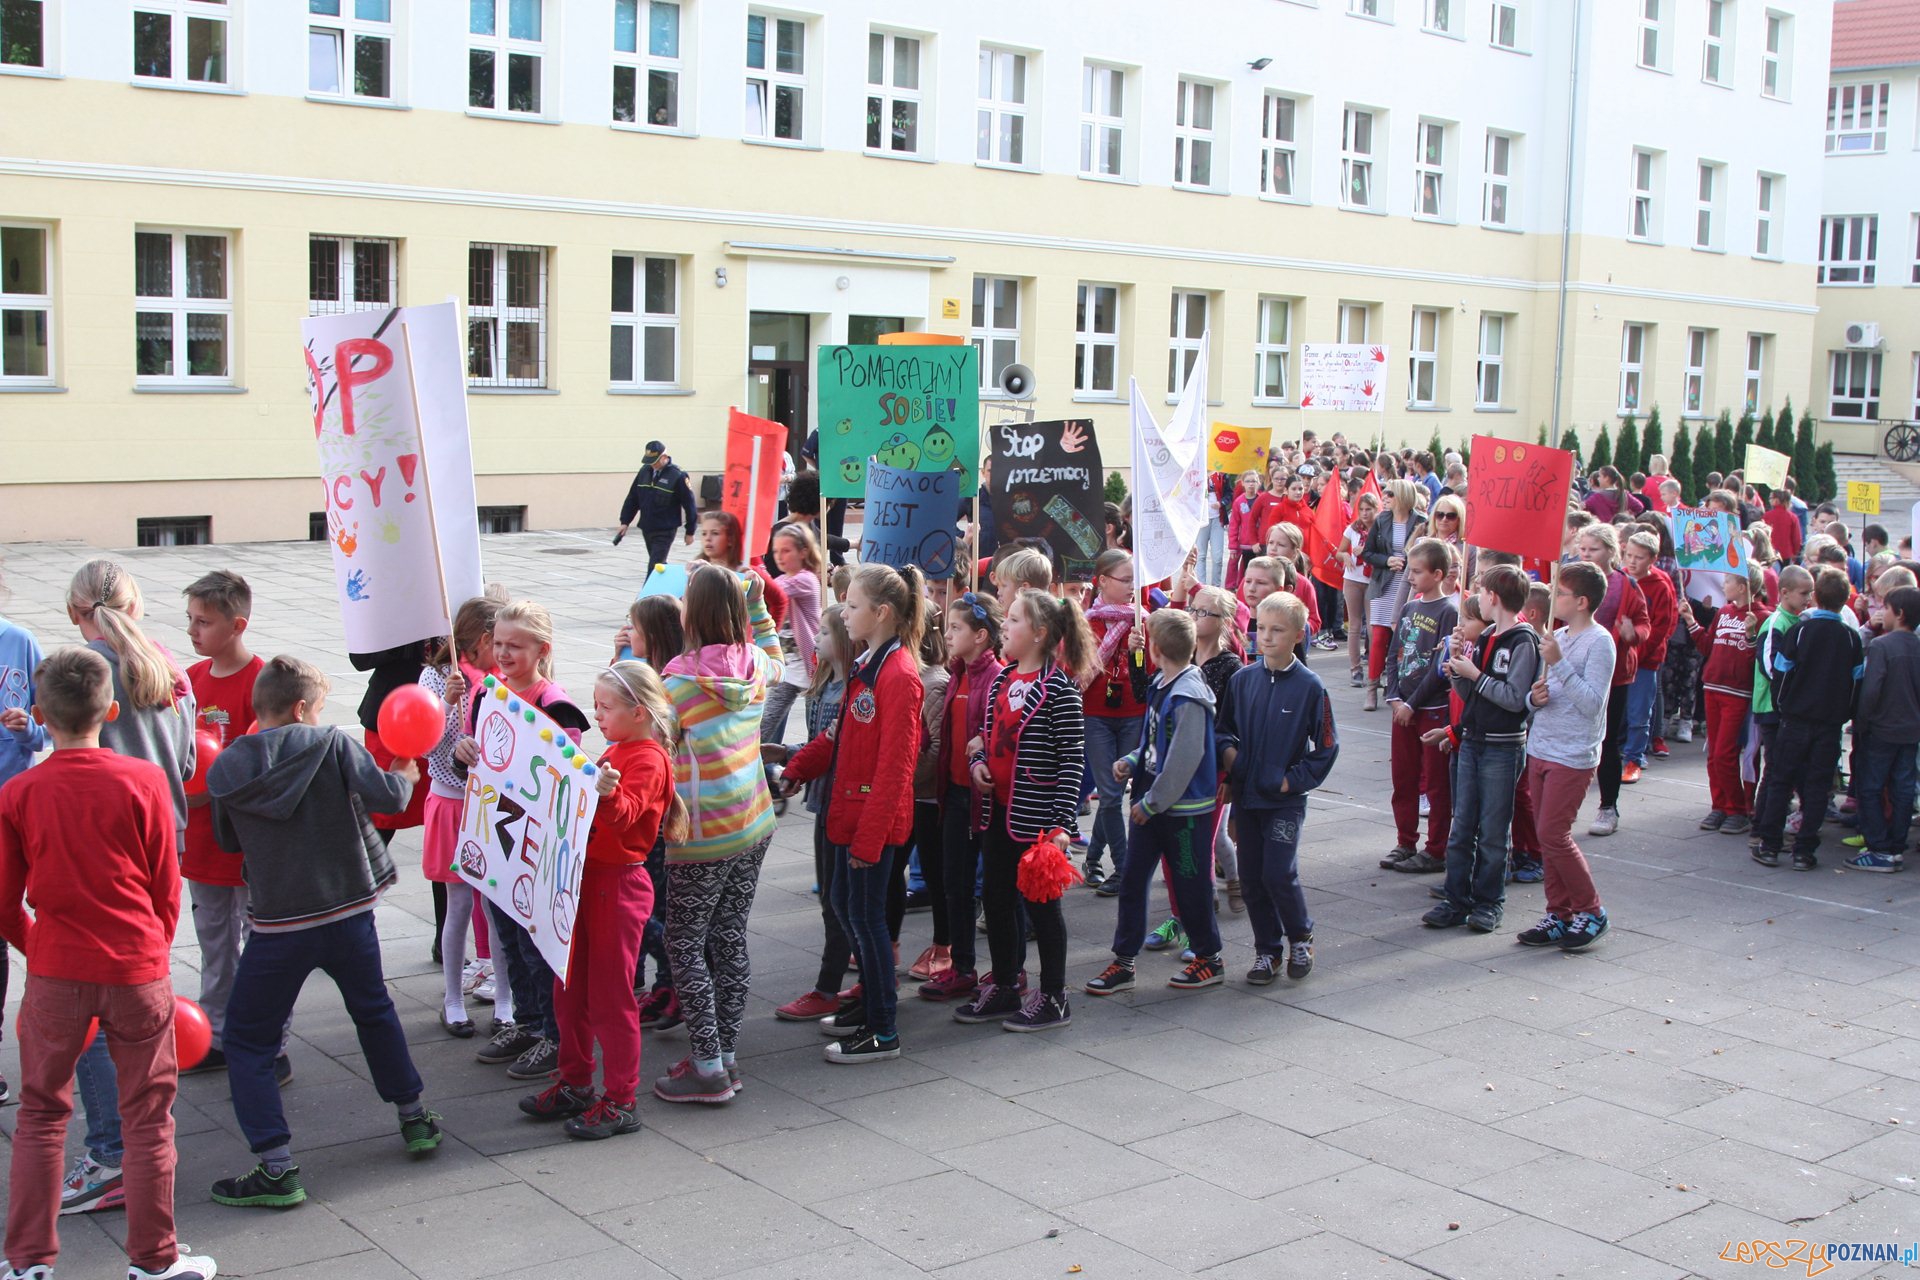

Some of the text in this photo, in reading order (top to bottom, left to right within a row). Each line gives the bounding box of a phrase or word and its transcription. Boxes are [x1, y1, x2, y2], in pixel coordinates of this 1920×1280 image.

[1217, 435, 1236, 445] STOP
[868, 465, 945, 494] PRZEMOC
[1856, 483, 1870, 497] STOP
[873, 501, 919, 529] JEST
[1493, 647, 1510, 674] C
[519, 754, 588, 850] STOP
